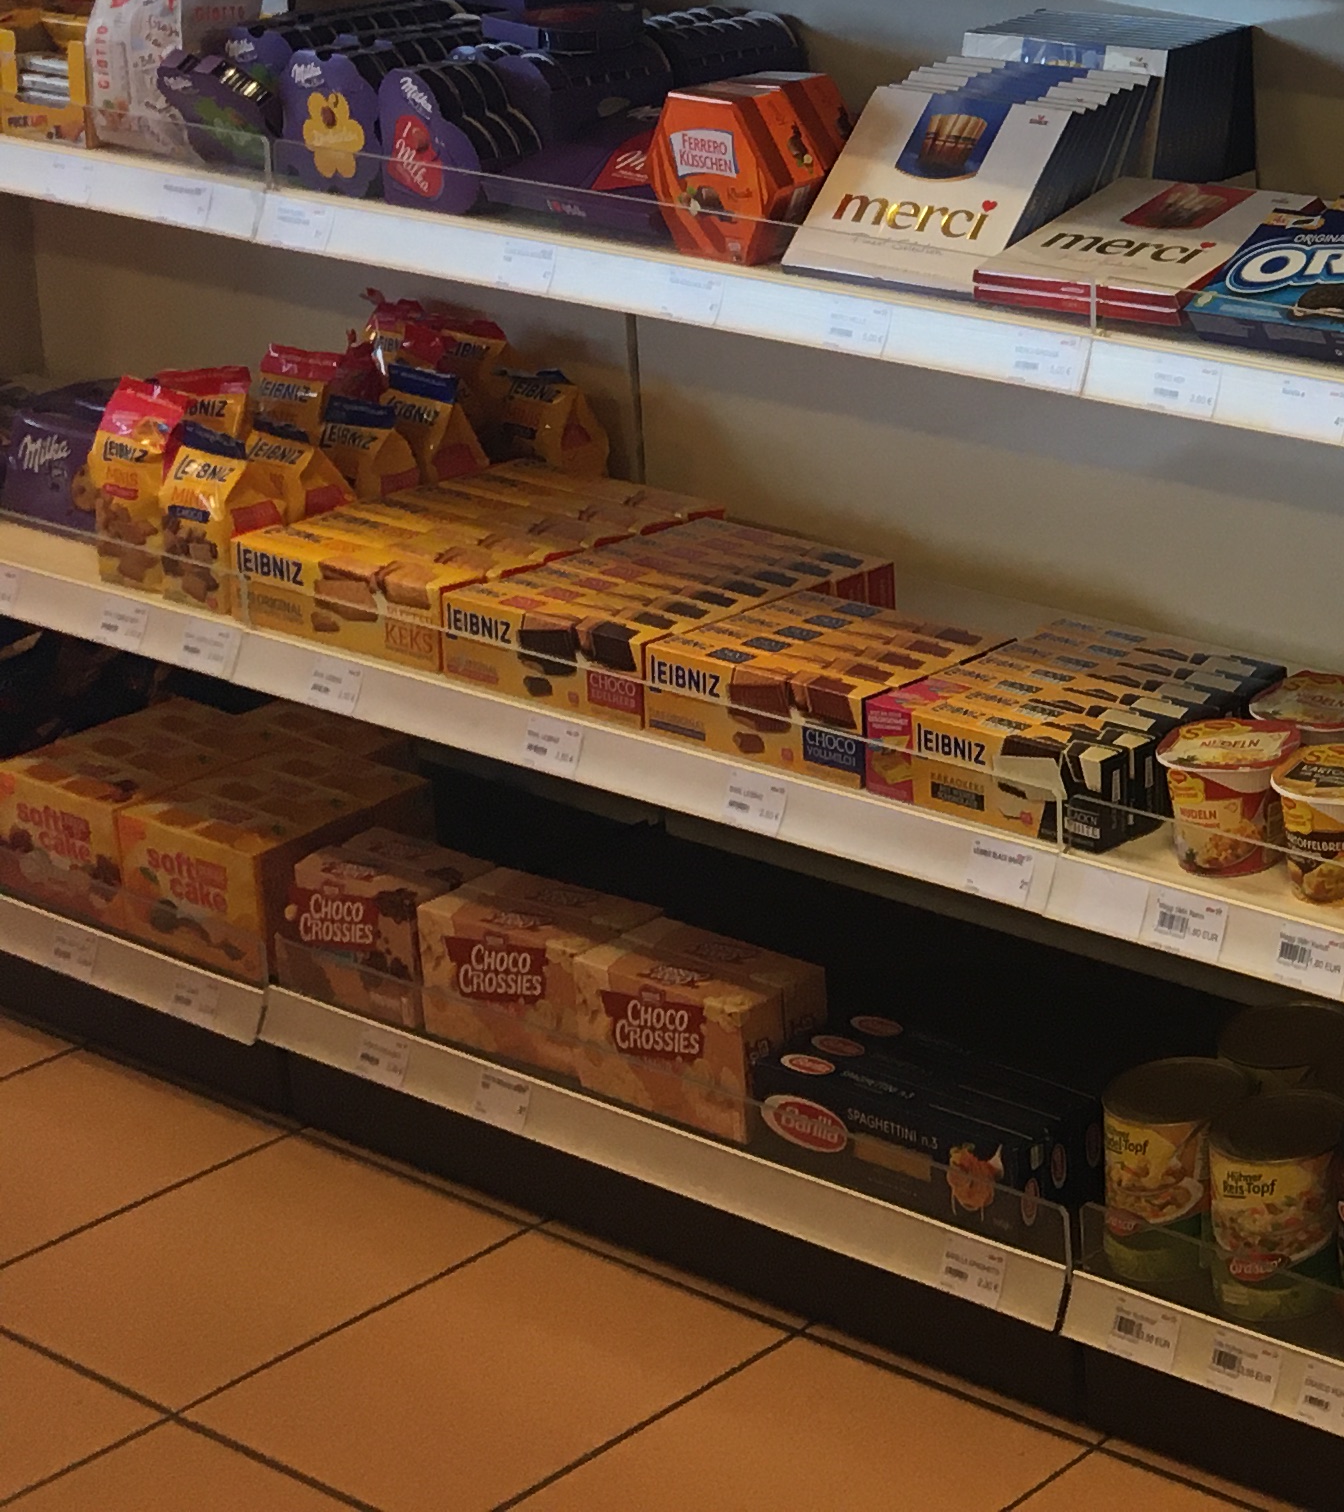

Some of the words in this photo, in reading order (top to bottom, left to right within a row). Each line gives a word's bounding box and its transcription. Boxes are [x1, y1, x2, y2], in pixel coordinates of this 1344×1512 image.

[679, 149, 734, 175] KÜSSCHEN
[681, 132, 728, 157] FERRERO
[832, 191, 995, 241] merci
[1041, 230, 1212, 266] merci
[17, 431, 72, 474] Milka
[237, 541, 304, 587] LEIBNIZ
[385, 623, 435, 656] KEKS
[447, 603, 512, 645] LEIBNIZ
[651, 653, 722, 699] LEIBNIZ
[805, 727, 858, 757] CHOCO
[917, 720, 988, 768] LEIBNIZ
[16, 799, 64, 833] soft
[1179, 806, 1218, 821] NUDELN
[39, 827, 93, 863] cake
[147, 845, 197, 876] soft
[169, 876, 229, 912] cake
[309, 893, 364, 925] CHOCO
[298, 912, 375, 945] CROSSIES
[470, 942, 533, 976] CHOCO
[459, 963, 544, 999] CROSSIES
[626, 998, 690, 1032] CHOCO
[615, 1019, 702, 1056] CROSSIES
